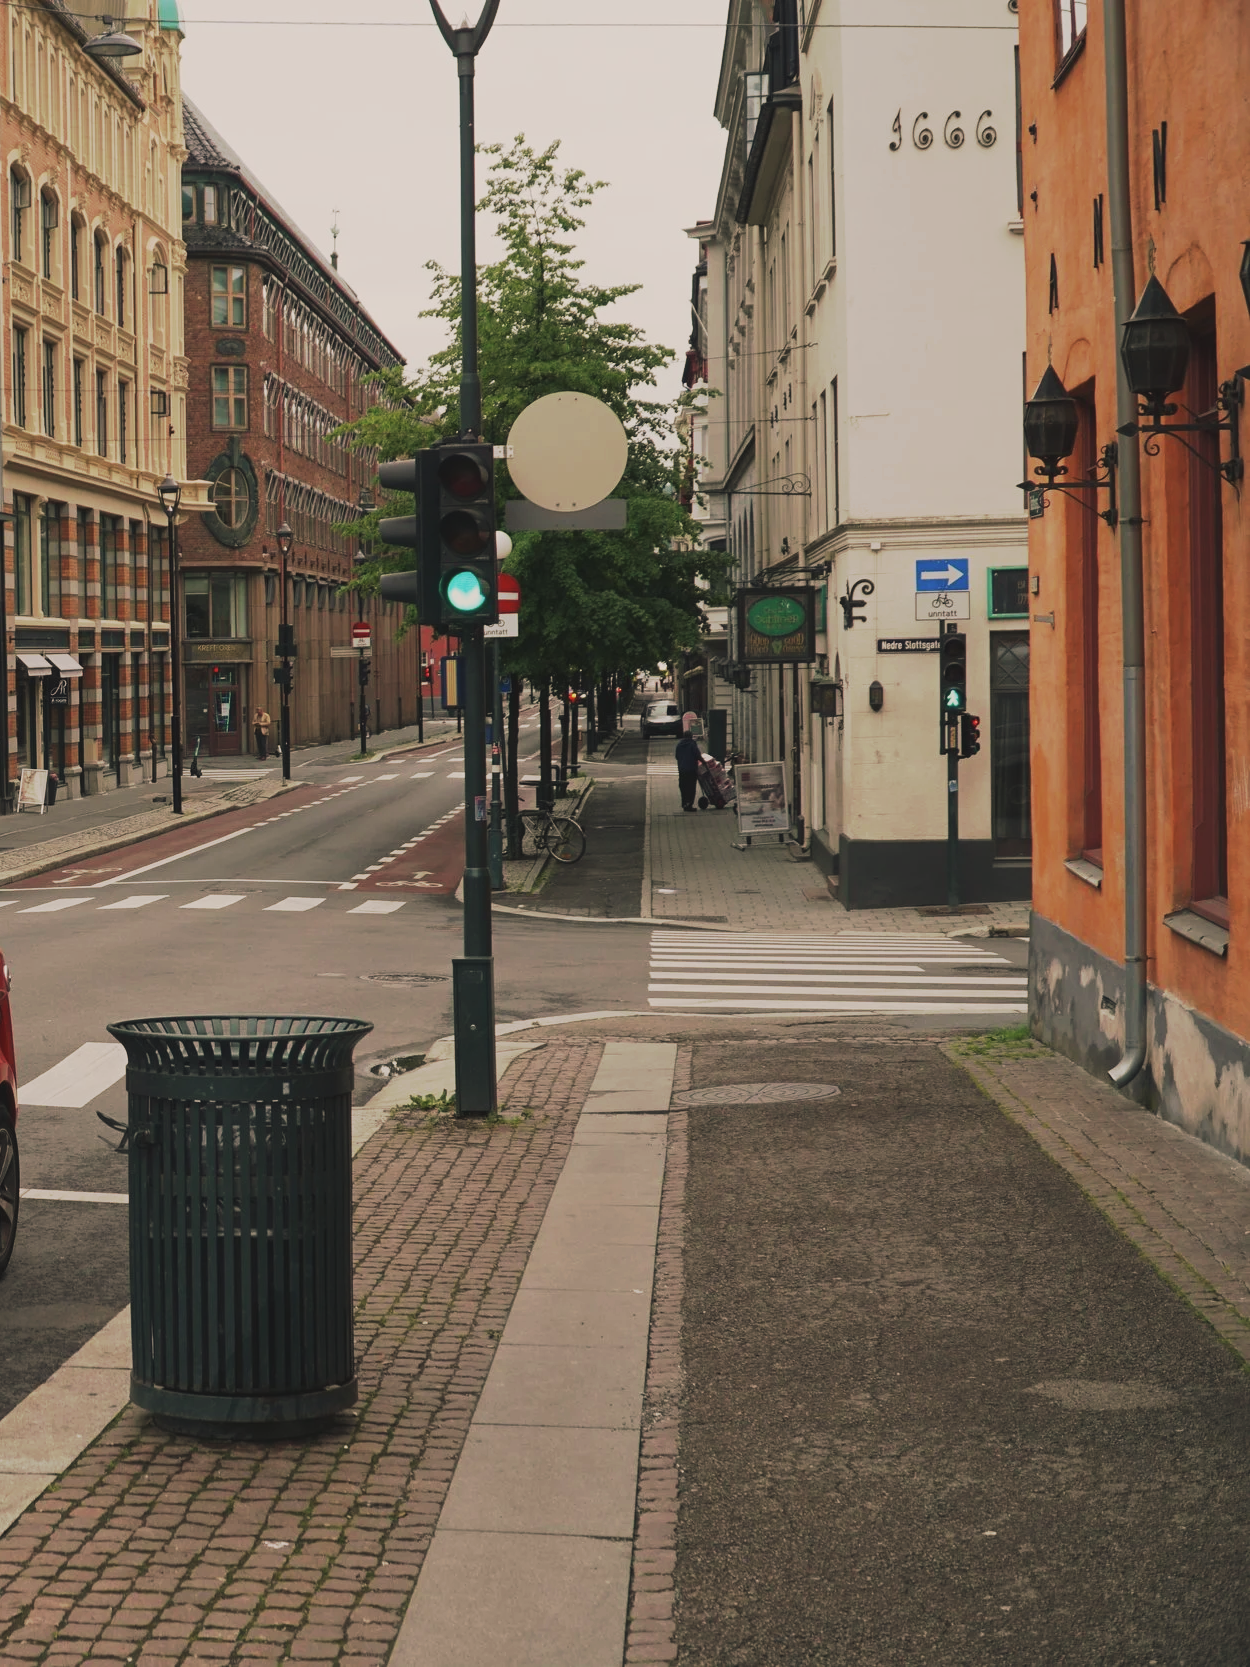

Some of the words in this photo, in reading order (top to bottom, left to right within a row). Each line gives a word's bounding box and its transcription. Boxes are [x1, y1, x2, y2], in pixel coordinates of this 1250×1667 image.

[888, 107, 997, 151] 1666
[927, 610, 958, 618] unntatt
[881, 640, 903, 650] Nedre
